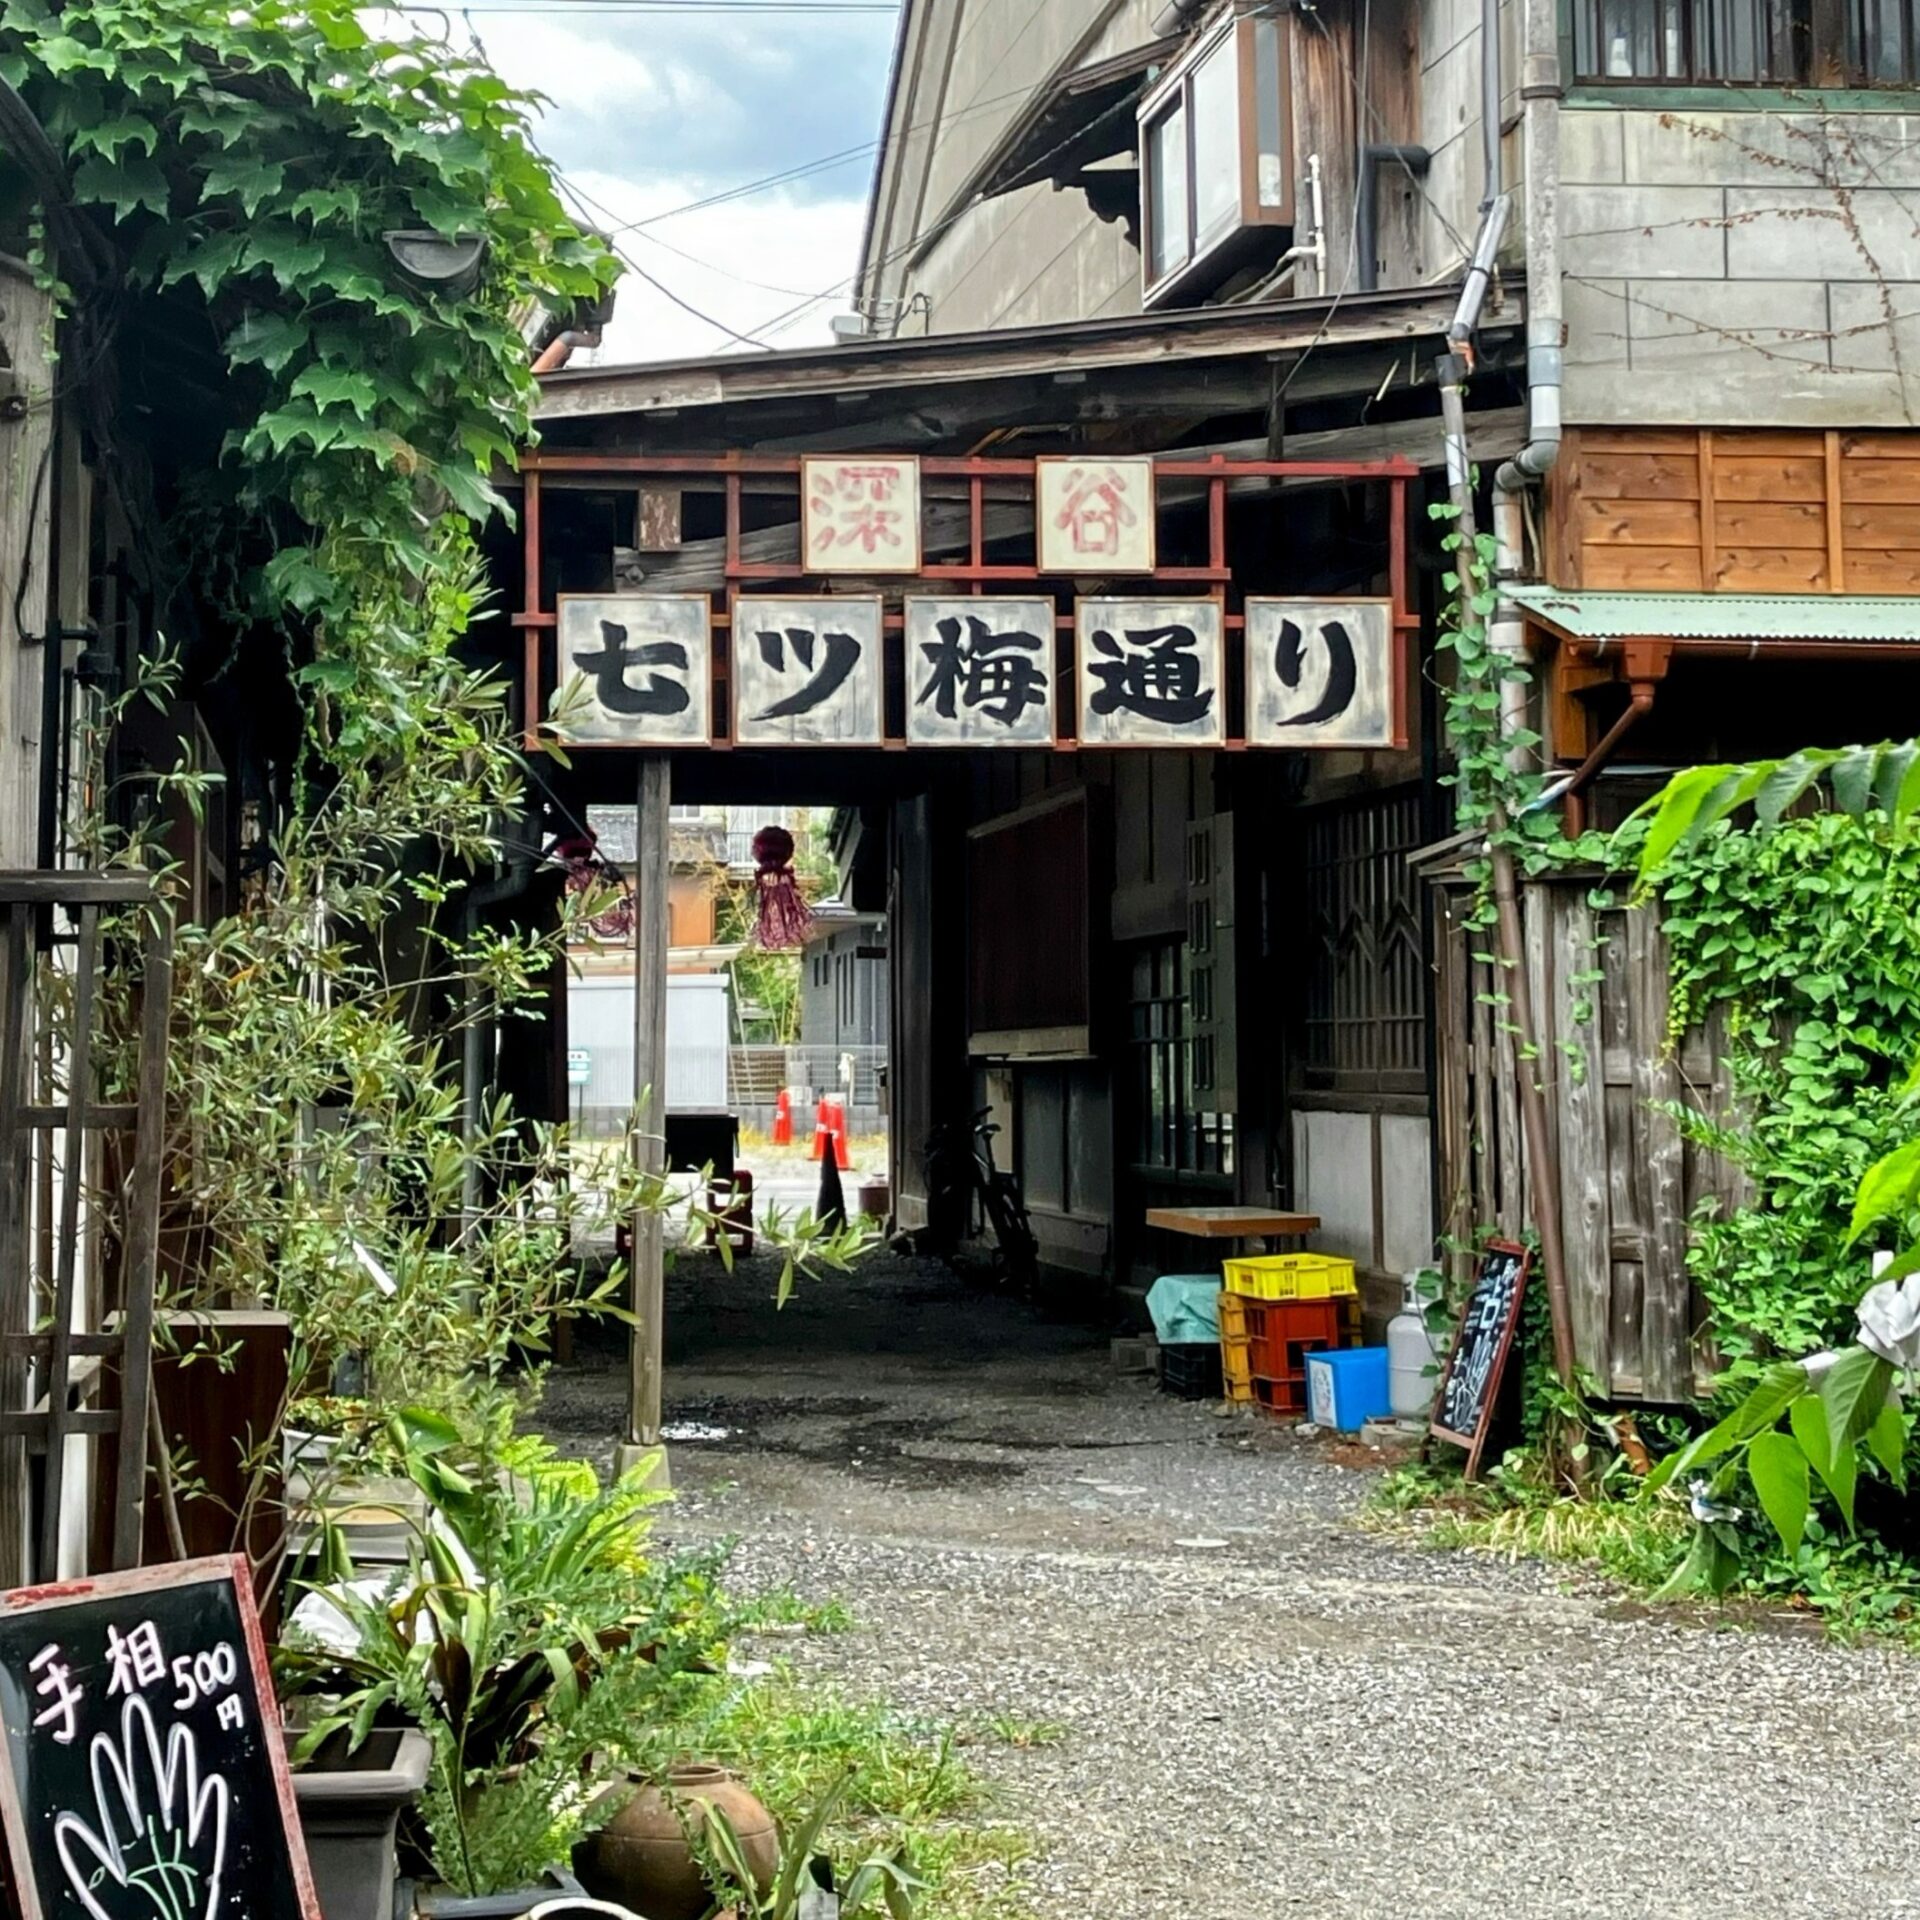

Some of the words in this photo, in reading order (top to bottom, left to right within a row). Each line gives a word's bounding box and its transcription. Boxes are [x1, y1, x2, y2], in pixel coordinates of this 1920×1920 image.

[810, 465, 1140, 556] 深谷
[573, 615, 1358, 727] 七ツ梅通り
[28, 1619, 167, 1744] 手相
[171, 1641, 237, 1711] 500
[216, 1693, 244, 1731] 円
